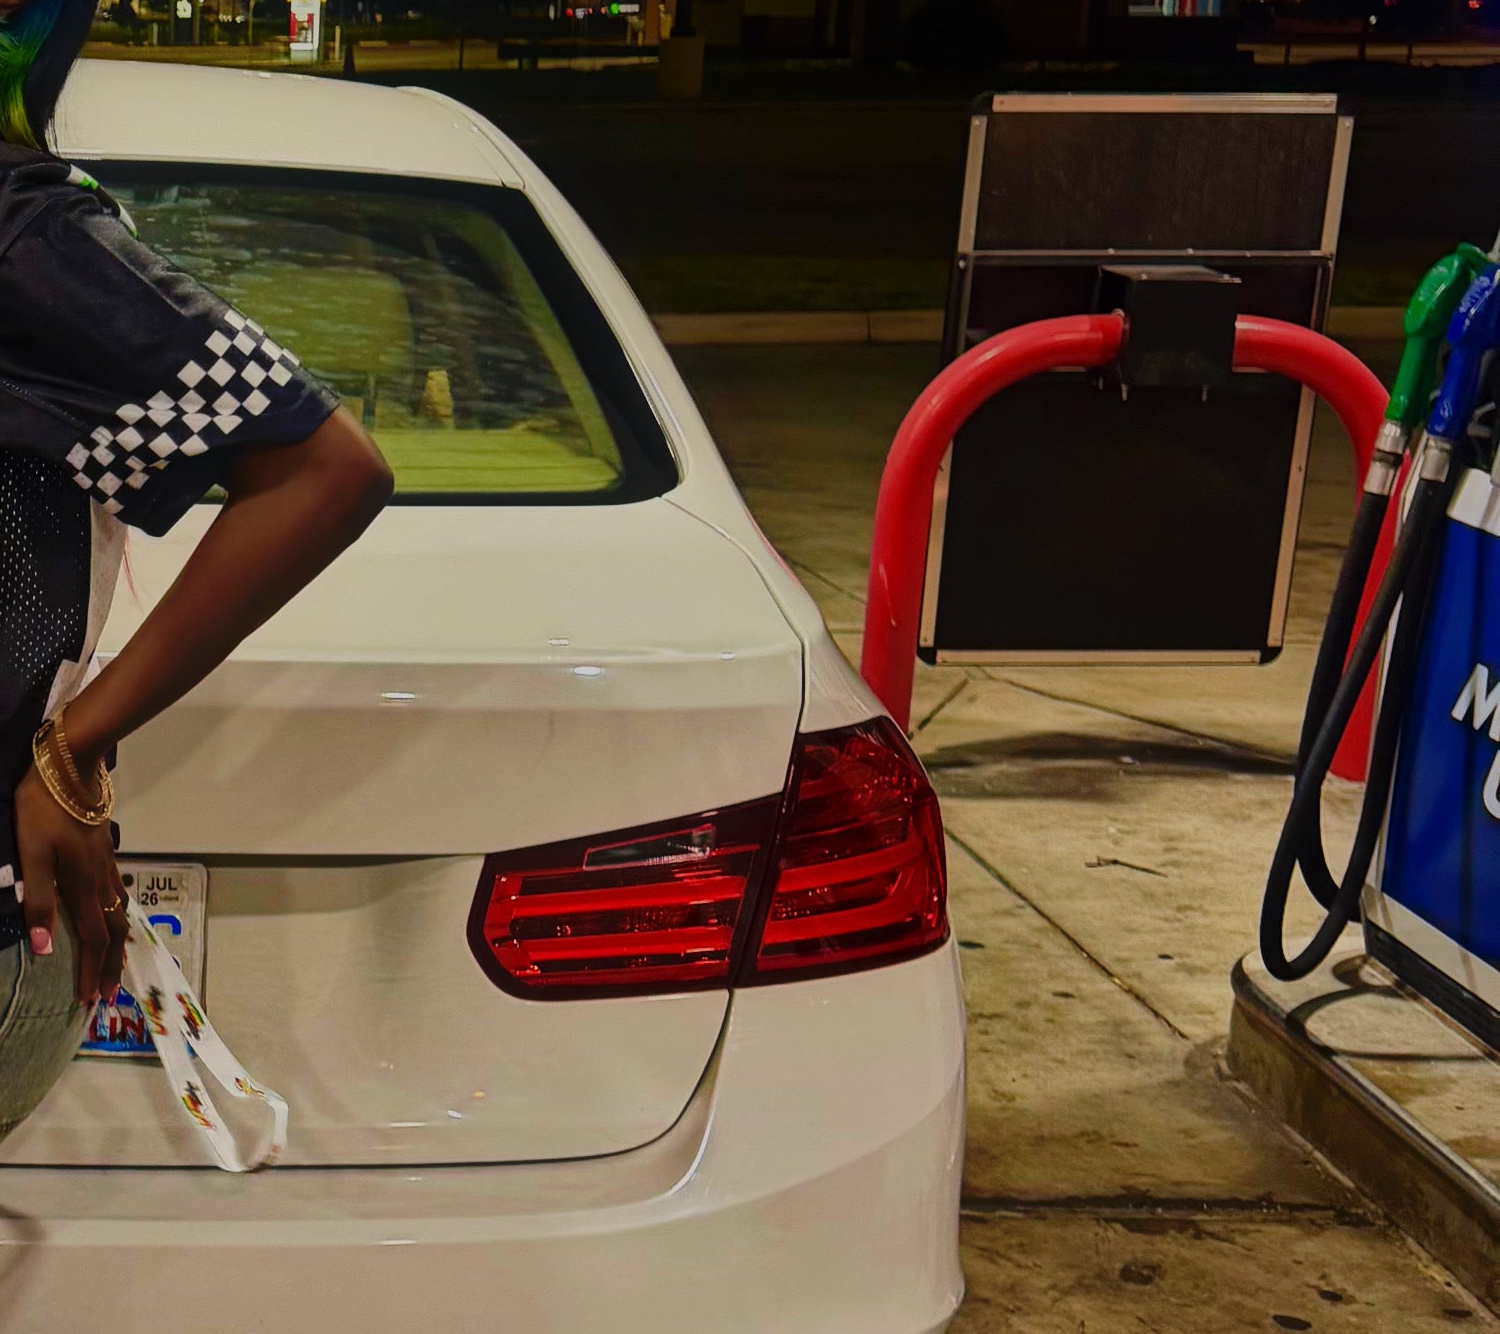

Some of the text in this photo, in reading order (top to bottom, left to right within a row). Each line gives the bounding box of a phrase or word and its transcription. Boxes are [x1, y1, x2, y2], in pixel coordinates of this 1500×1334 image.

[146, 876, 178, 892] JUL
[140, 892, 159, 907] 26
[88, 1015, 149, 1044] LIN
